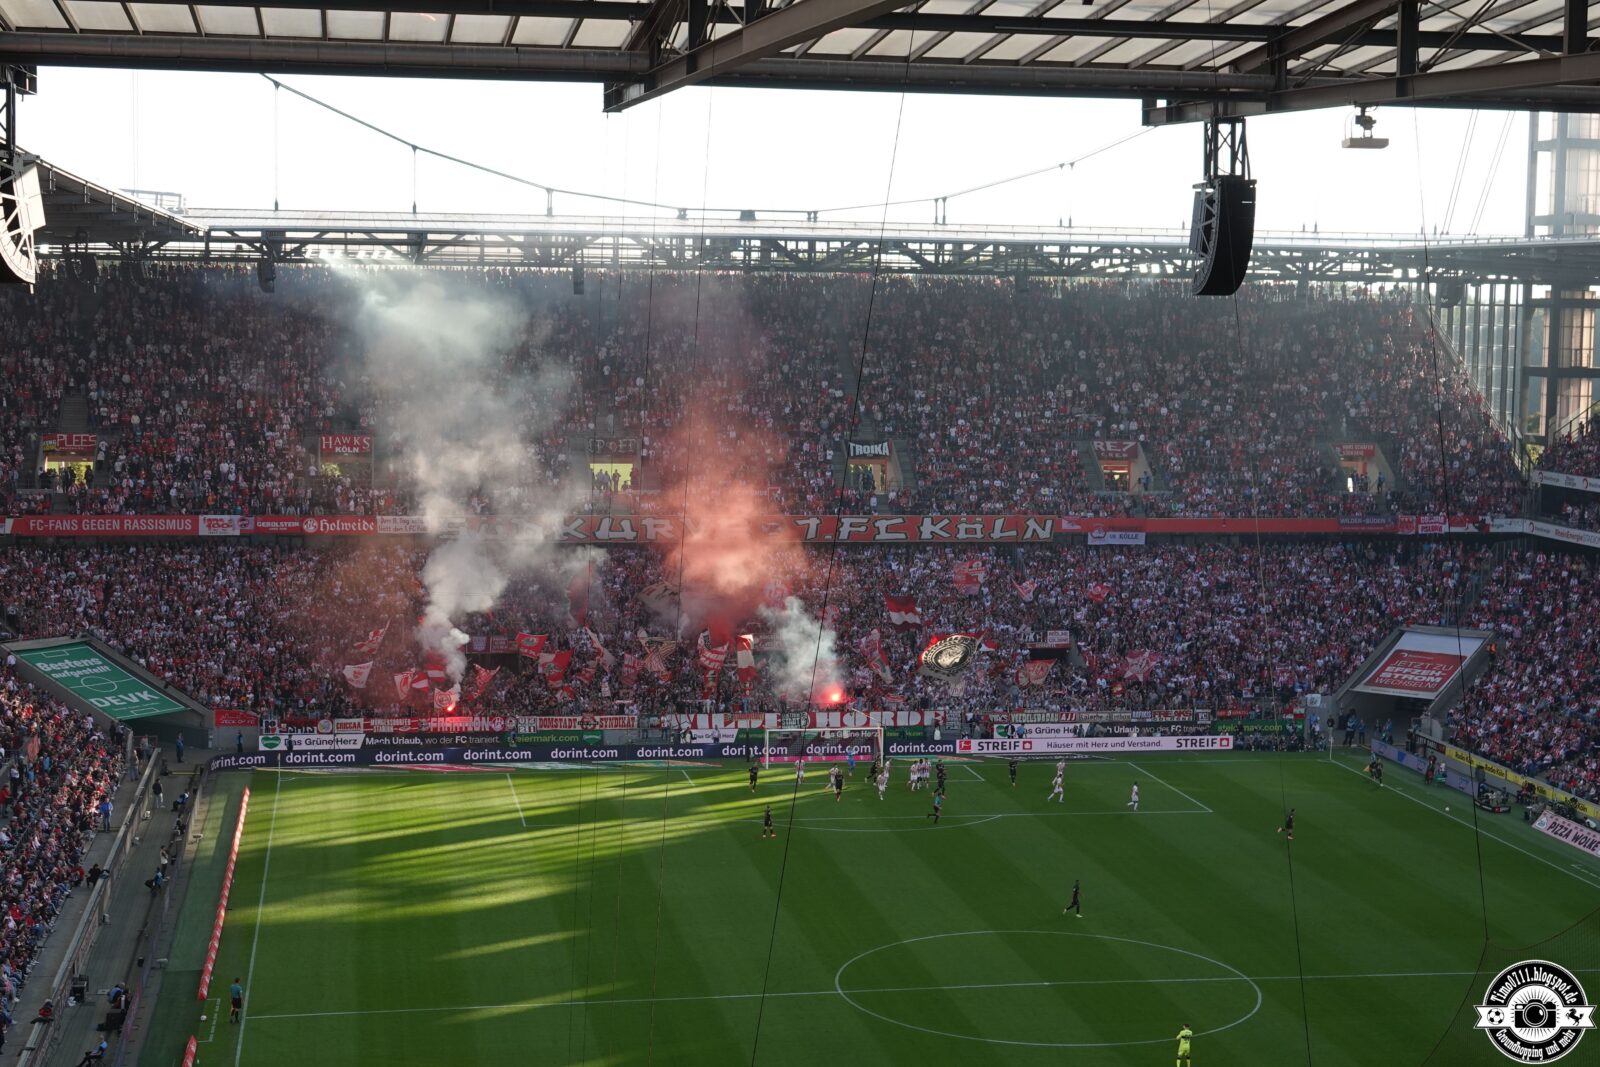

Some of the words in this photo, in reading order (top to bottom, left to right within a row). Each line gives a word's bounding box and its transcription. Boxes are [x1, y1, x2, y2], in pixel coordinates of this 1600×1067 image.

[322, 436, 371, 449] HAWKS
[849, 441, 889, 456] TROIKA
[335, 445, 359, 453] KÖLN
[29, 519, 78, 531] FC-FANS
[82, 519, 120, 531] GEGEN
[124, 519, 192, 531] RASSISMUS
[320, 519, 374, 531] Holweide
[919, 517, 1054, 540] KÖLN
[35, 657, 102, 672] Bestens
[1390, 659, 1432, 669] JETZT
[1432, 663, 1454, 671] ZU
[51, 665, 112, 679] aufgestellt
[1385, 666, 1446, 676] EFFZEH-
[1375, 677, 1438, 689] WECHSELN!
[1379, 672, 1441, 683] STROM
[88, 690, 160, 708] DEVK
[539, 717, 577, 729] DOMSTADT
[599, 717, 635, 729] SYNDIKAT
[815, 711, 945, 728] HORDE
[1035, 727, 1061, 735] Grüne
[1171, 724, 1182, 732] FC
[304, 737, 334, 746] Grüne
[336, 737, 357, 746] Herz
[392, 736, 423, 746] Urlaub,
[439, 736, 453, 744] der
[455, 736, 467, 744] FC
[508, 734, 579, 744] seiermark.com
[1047, 741, 1073, 749] Häuser
[1091, 740, 1107, 748] Herz
[1109, 740, 1126, 748] und
[1127, 739, 1163, 748] Verstand.
[1176, 738, 1218, 748] STREIF
[637, 746, 704, 758] dorint.com
[806, 743, 871, 755] dorint.com
[889, 743, 954, 754] dorint.com
[978, 741, 1020, 751] STREIF
[286, 752, 356, 763] dorint.com
[375, 751, 444, 763] dorint.com
[463, 749, 532, 761] dorint.com
[550, 748, 618, 759] dorint.com
[210, 753, 266, 770] dorint.com
[1547, 821, 1573, 839] PIZZA
[1572, 832, 1600, 852] WOLKE
